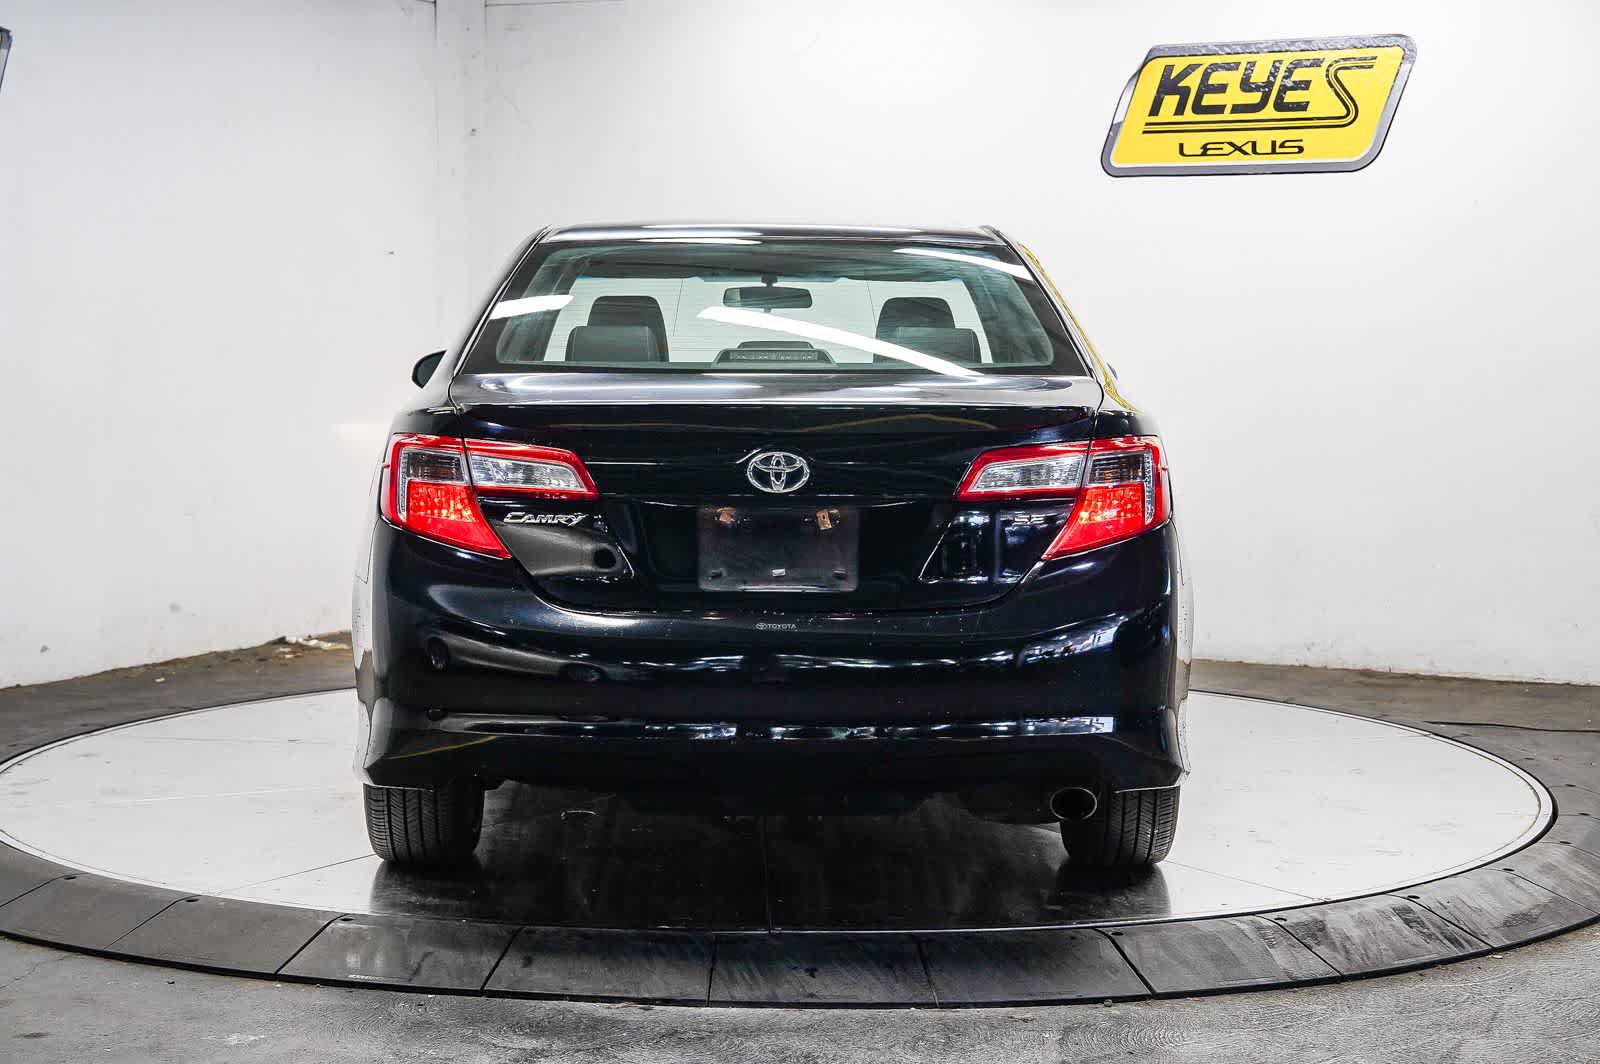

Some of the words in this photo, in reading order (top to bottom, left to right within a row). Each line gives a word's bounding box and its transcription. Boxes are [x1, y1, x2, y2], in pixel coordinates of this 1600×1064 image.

[1145, 56, 1377, 129] KEYES
[1178, 139, 1304, 157] LEXUS
[503, 511, 590, 527] CAMRY
